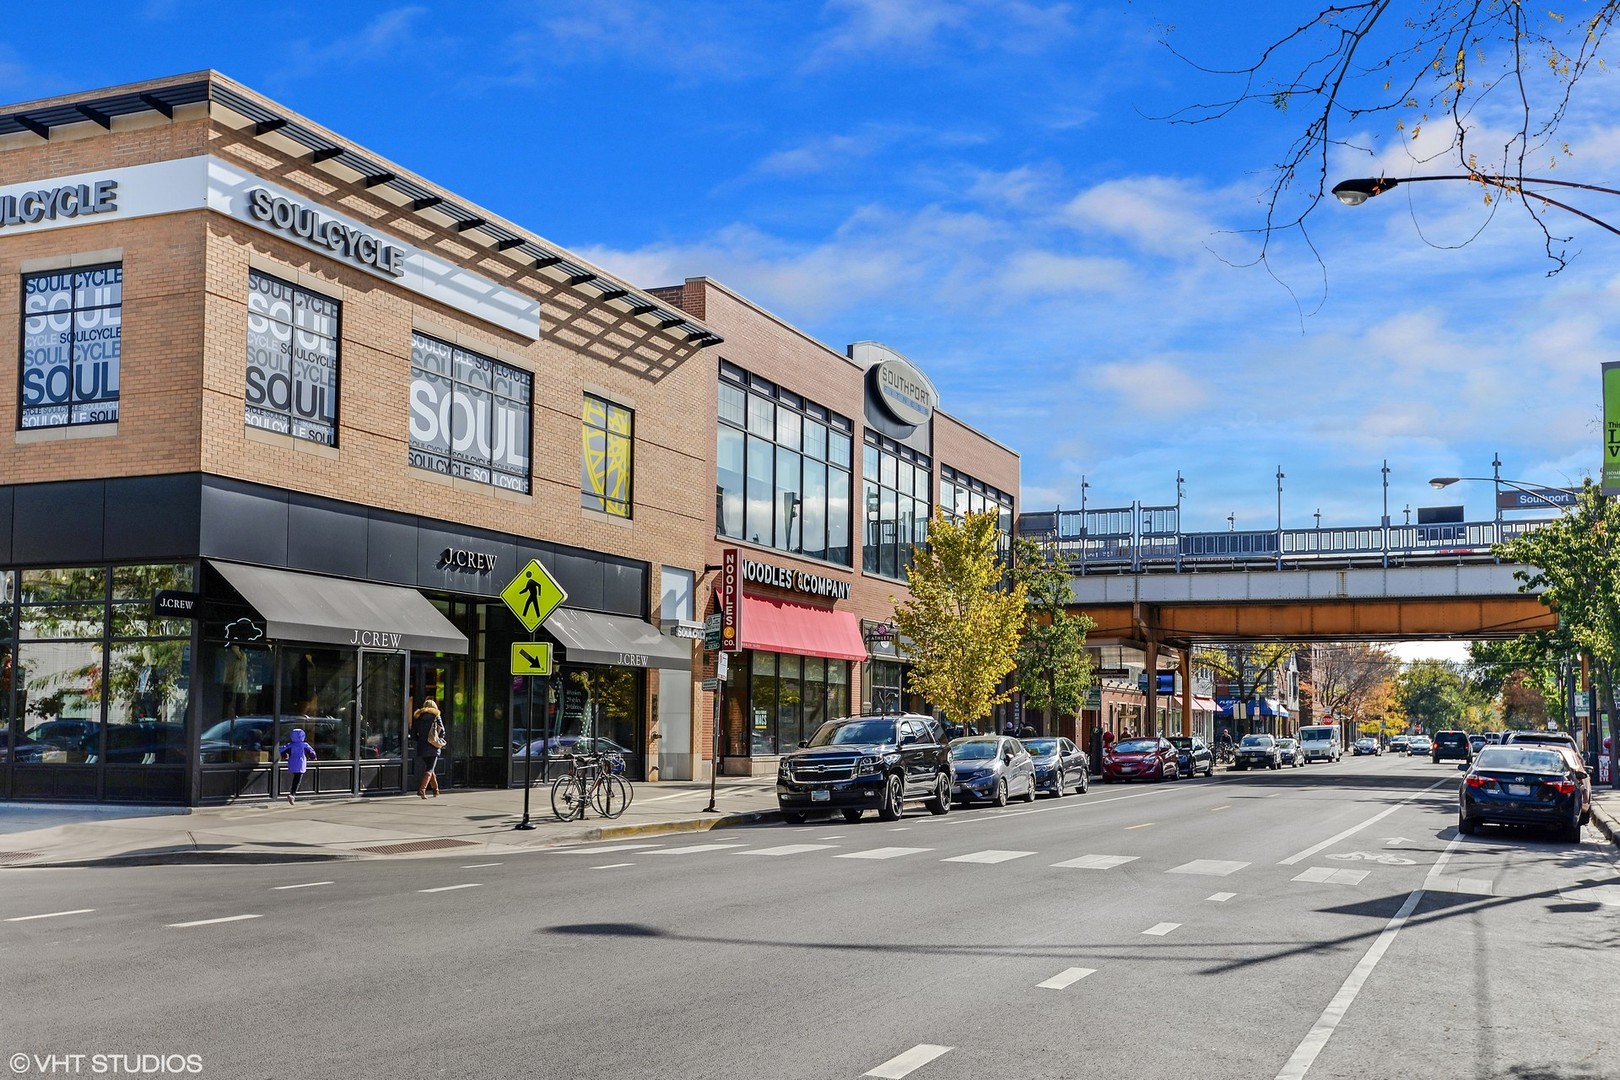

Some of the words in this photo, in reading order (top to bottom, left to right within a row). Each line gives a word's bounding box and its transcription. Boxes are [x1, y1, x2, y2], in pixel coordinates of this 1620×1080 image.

[249, 189, 405, 277] SOULCYCLE
[26, 268, 122, 294] SOULCYCLE
[249, 273, 337, 319] SOULCYCLE
[25, 287, 121, 335] SOUL
[248, 292, 336, 356] SOUL
[25, 333, 58, 348] CYCLE
[60, 326, 121, 344] SOULCYCLE
[25, 340, 120, 367] SOULCYCLE
[280, 342, 336, 371] SOULCYCLE
[23, 361, 119, 405] SOUL
[247, 345, 336, 388] SOULCYCLE
[882, 366, 930, 406] SOUTHPORT
[246, 365, 335, 426] SOUL
[409, 379, 529, 468] SOUL
[443, 547, 497, 571] J.CREW
[742, 559, 792, 589] NOODLES
[803, 573, 852, 600] COMPANY
[160, 597, 194, 610] J.CREW
[726, 554, 734, 626] NOODLES
[350, 630, 402, 647] J.CREW
[617, 653, 649, 666] J.CREW
